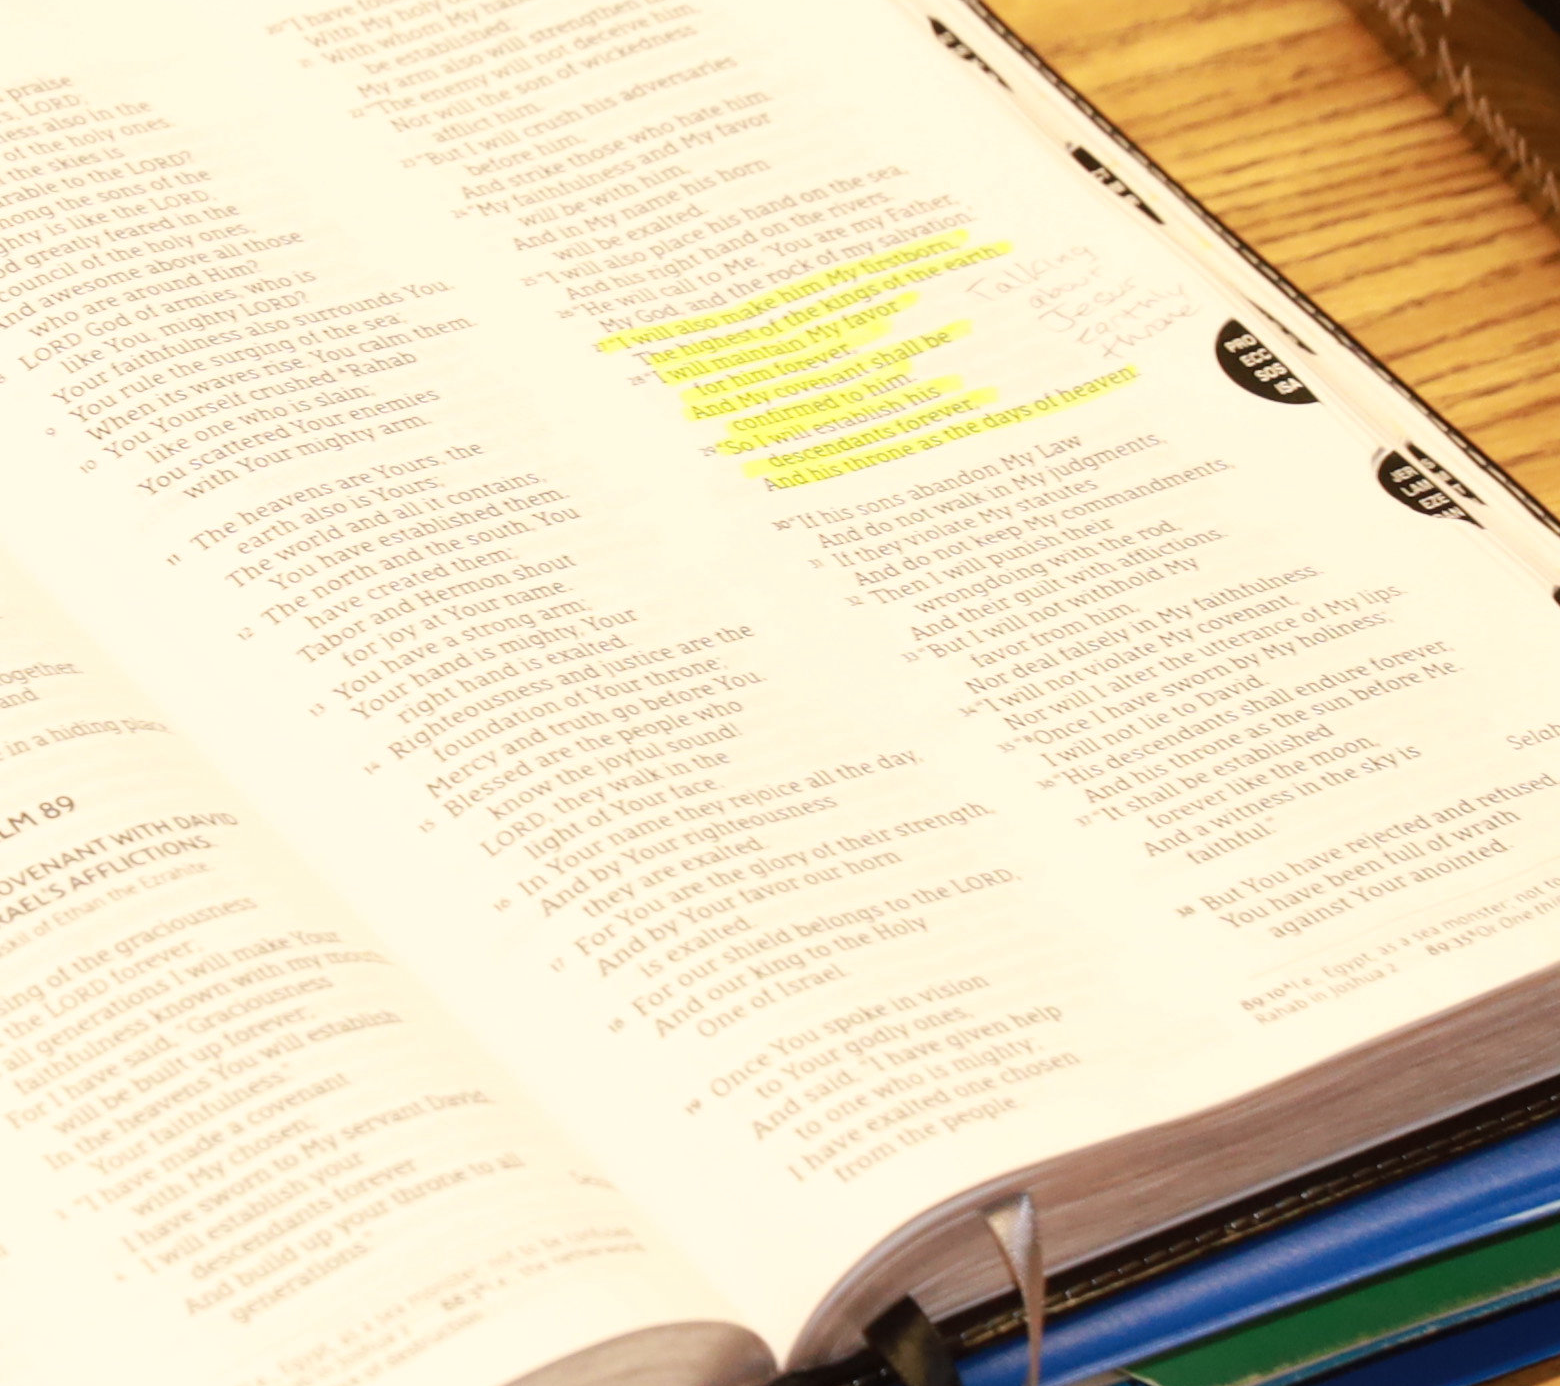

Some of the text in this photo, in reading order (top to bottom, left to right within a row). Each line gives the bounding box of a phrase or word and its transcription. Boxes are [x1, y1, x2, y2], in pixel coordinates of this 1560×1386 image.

[608, 240, 961, 350] "I will also make him My firstborn,
[631, 247, 1005, 366] The highest of the kings of the earth.
[966, 246, 1098, 302] Talking
[666, 359, 710, 379] will
[709, 338, 807, 370] maintain
[840, 300, 900, 329] favor
[692, 342, 858, 395] for him forever,
[1223, 333, 1257, 353] PRO
[1239, 348, 1272, 367] ECC
[1254, 362, 1287, 382] SOS
[690, 331, 952, 419] And My covenant shall be
[731, 373, 917, 431] confirmed to him.
[762, 367, 1142, 492] And his throne as the days of heaven.
[189, 443, 484, 550] The heavens are Yours, the
[38, 795, 76, 819] 89
[109, 820, 172, 846] WITH
[171, 811, 239, 830] DAVID
[69, 834, 218, 891] AFFLICTIONS.
[1199, 887, 1244, 911] But
[1240, 870, 1290, 893] You
[1285, 847, 1343, 876] have
[1344, 814, 1432, 853] rejected
[1431, 798, 1476, 824] and
[1218, 810, 1521, 928] You have been full of wrath
[1269, 837, 1513, 938] against Your anointed.
